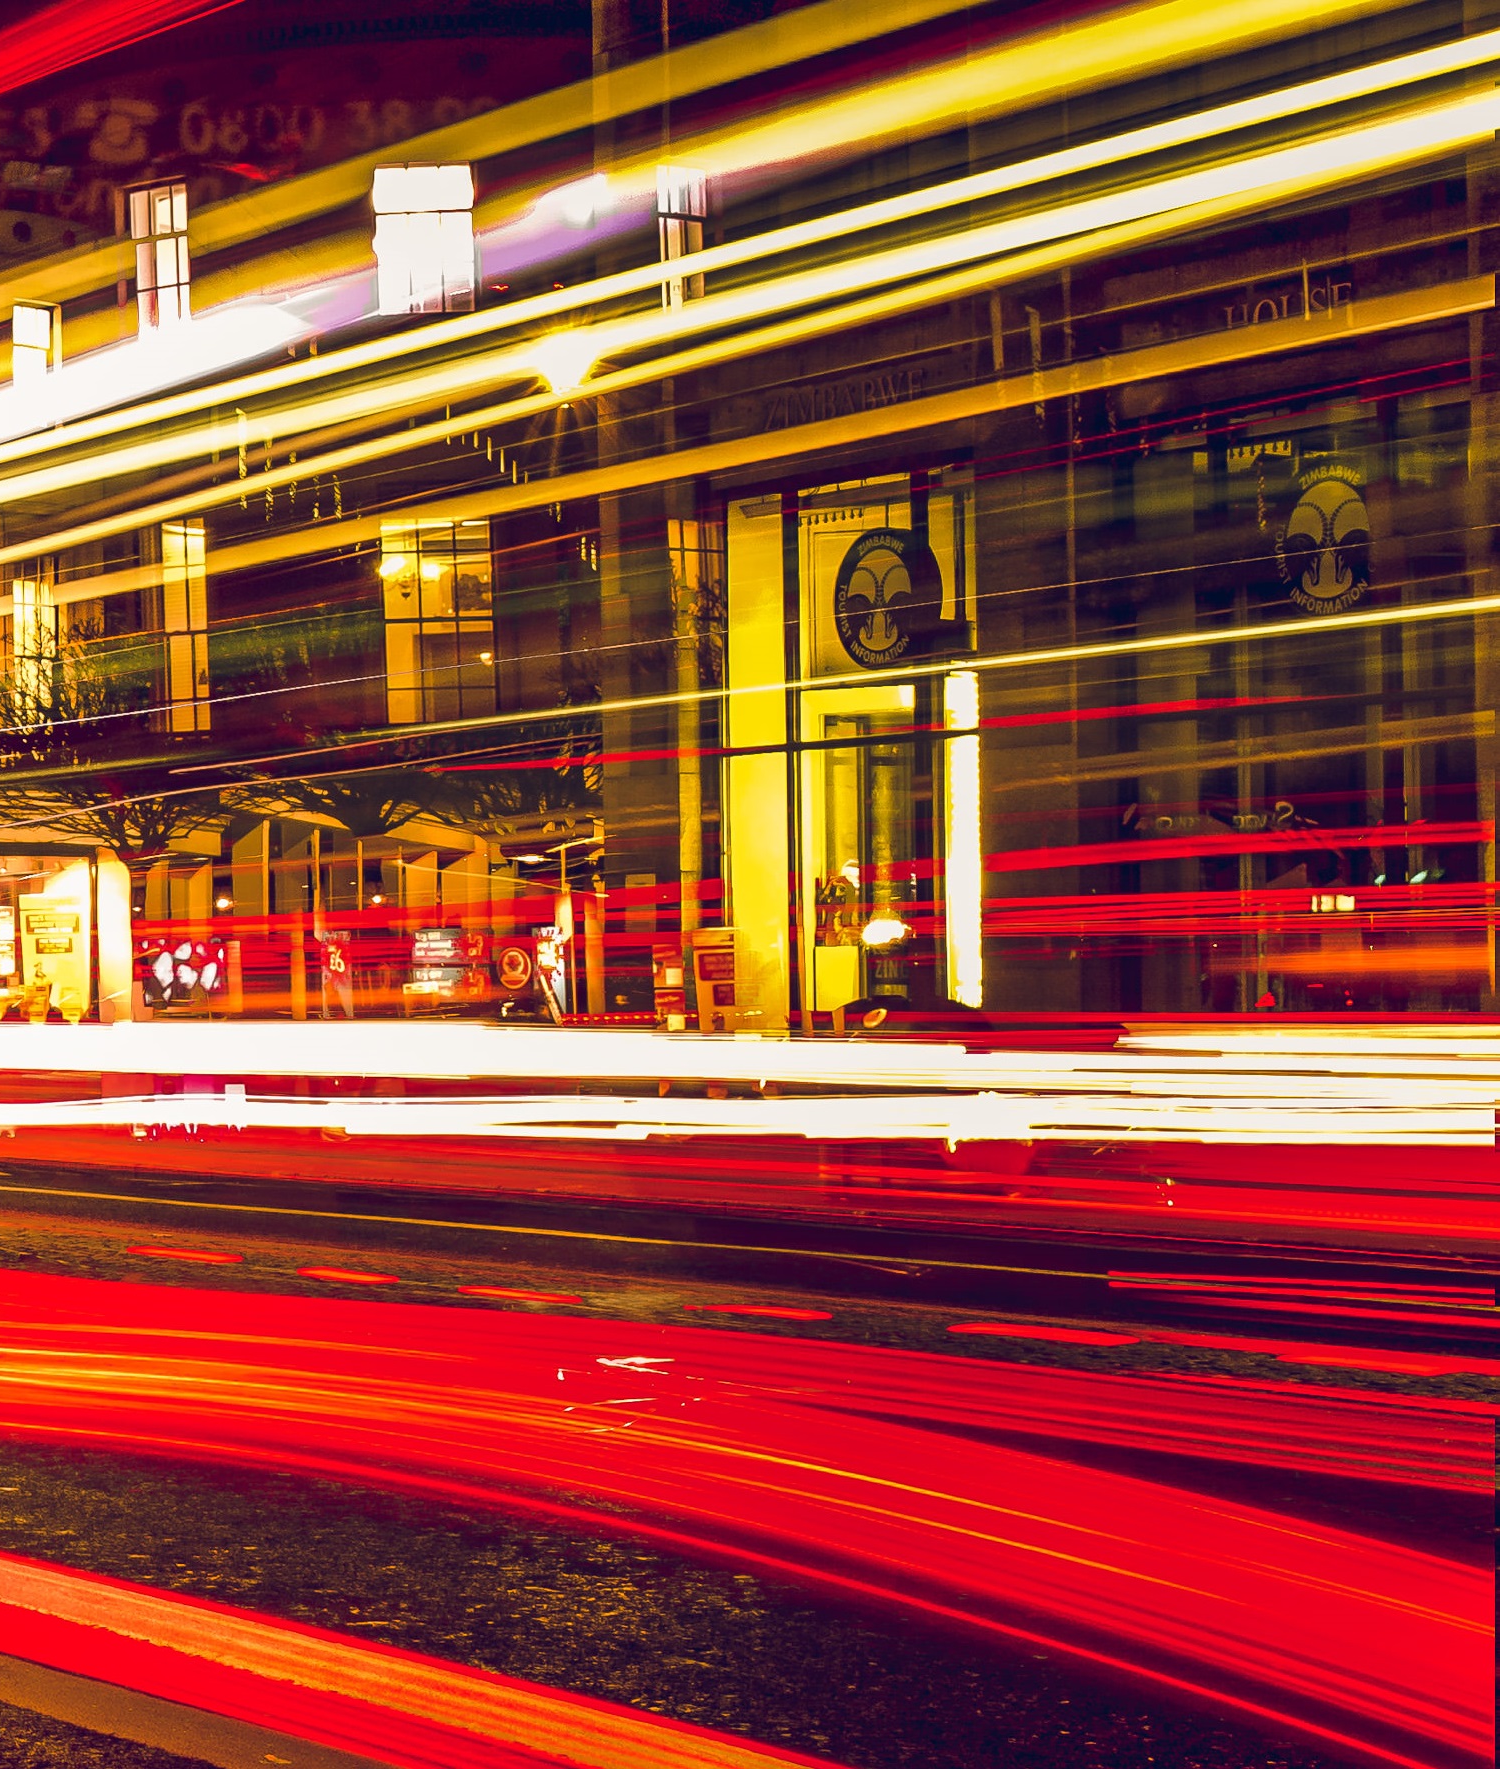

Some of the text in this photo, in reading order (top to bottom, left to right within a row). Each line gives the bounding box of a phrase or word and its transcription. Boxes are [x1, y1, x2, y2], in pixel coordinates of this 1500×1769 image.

[764, 369, 924, 432] ZIMBABWE
[1299, 464, 1362, 490] ZIMBABWE
[857, 535, 905, 556] ZIMBABWE
[1274, 524, 1292, 585] TOURIST
[838, 584, 852, 638] TOURIST
[1289, 578, 1369, 615] INFORMATION
[851, 634, 910, 664] INFORMATION
